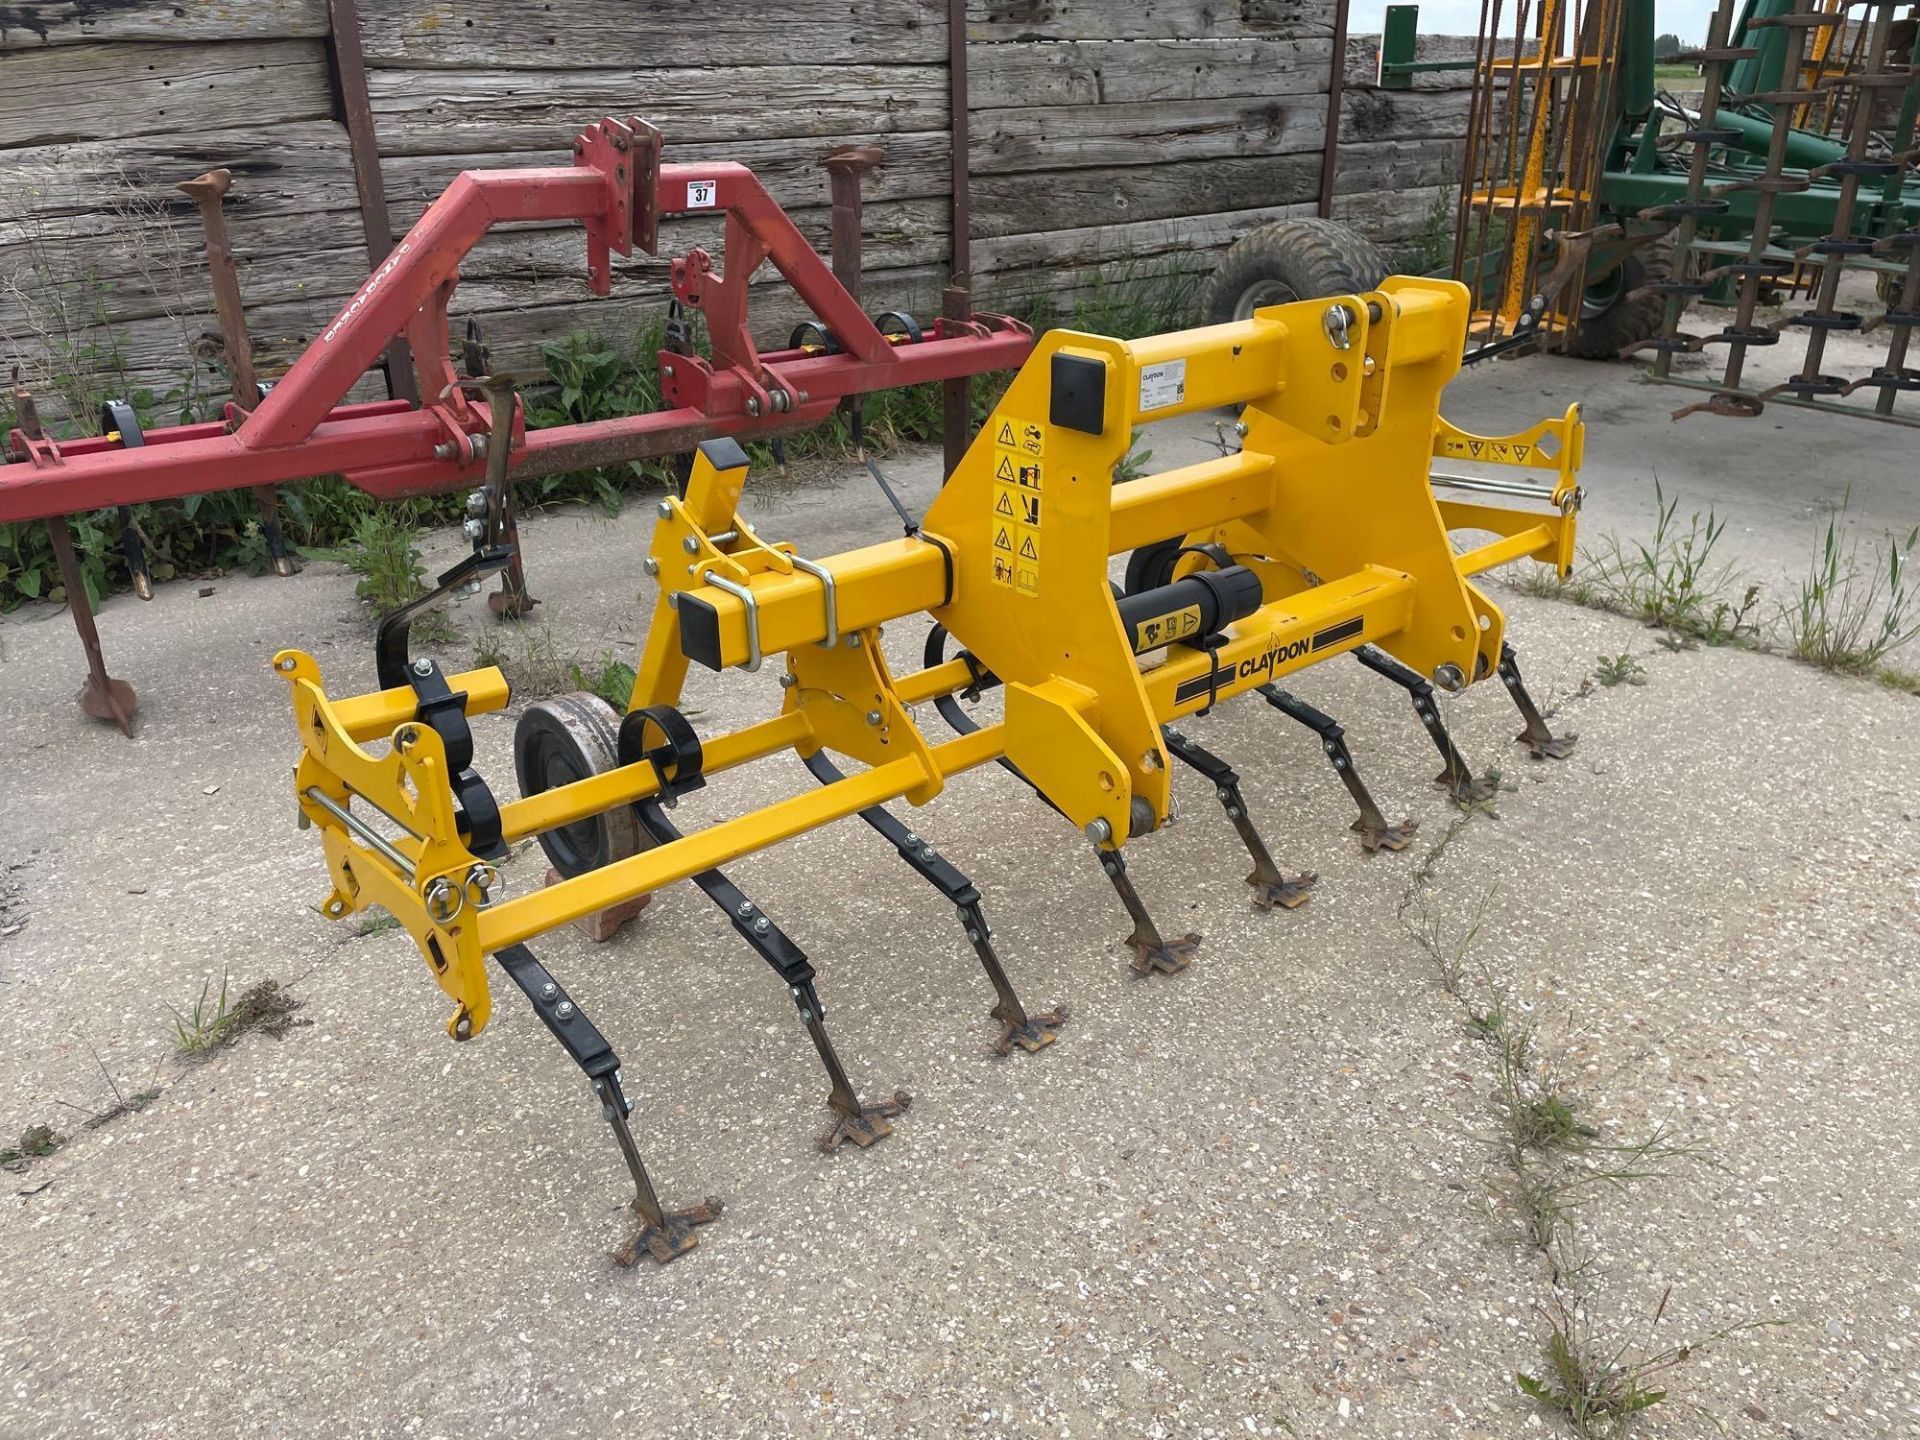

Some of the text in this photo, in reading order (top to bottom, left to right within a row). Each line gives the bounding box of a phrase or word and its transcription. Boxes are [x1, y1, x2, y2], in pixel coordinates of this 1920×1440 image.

[695, 188, 708, 202] 37
[323, 243, 410, 343] PANCRACKER
[1142, 371, 1164, 382] CLAYDON
[1238, 637, 1311, 681] CLAYDON
